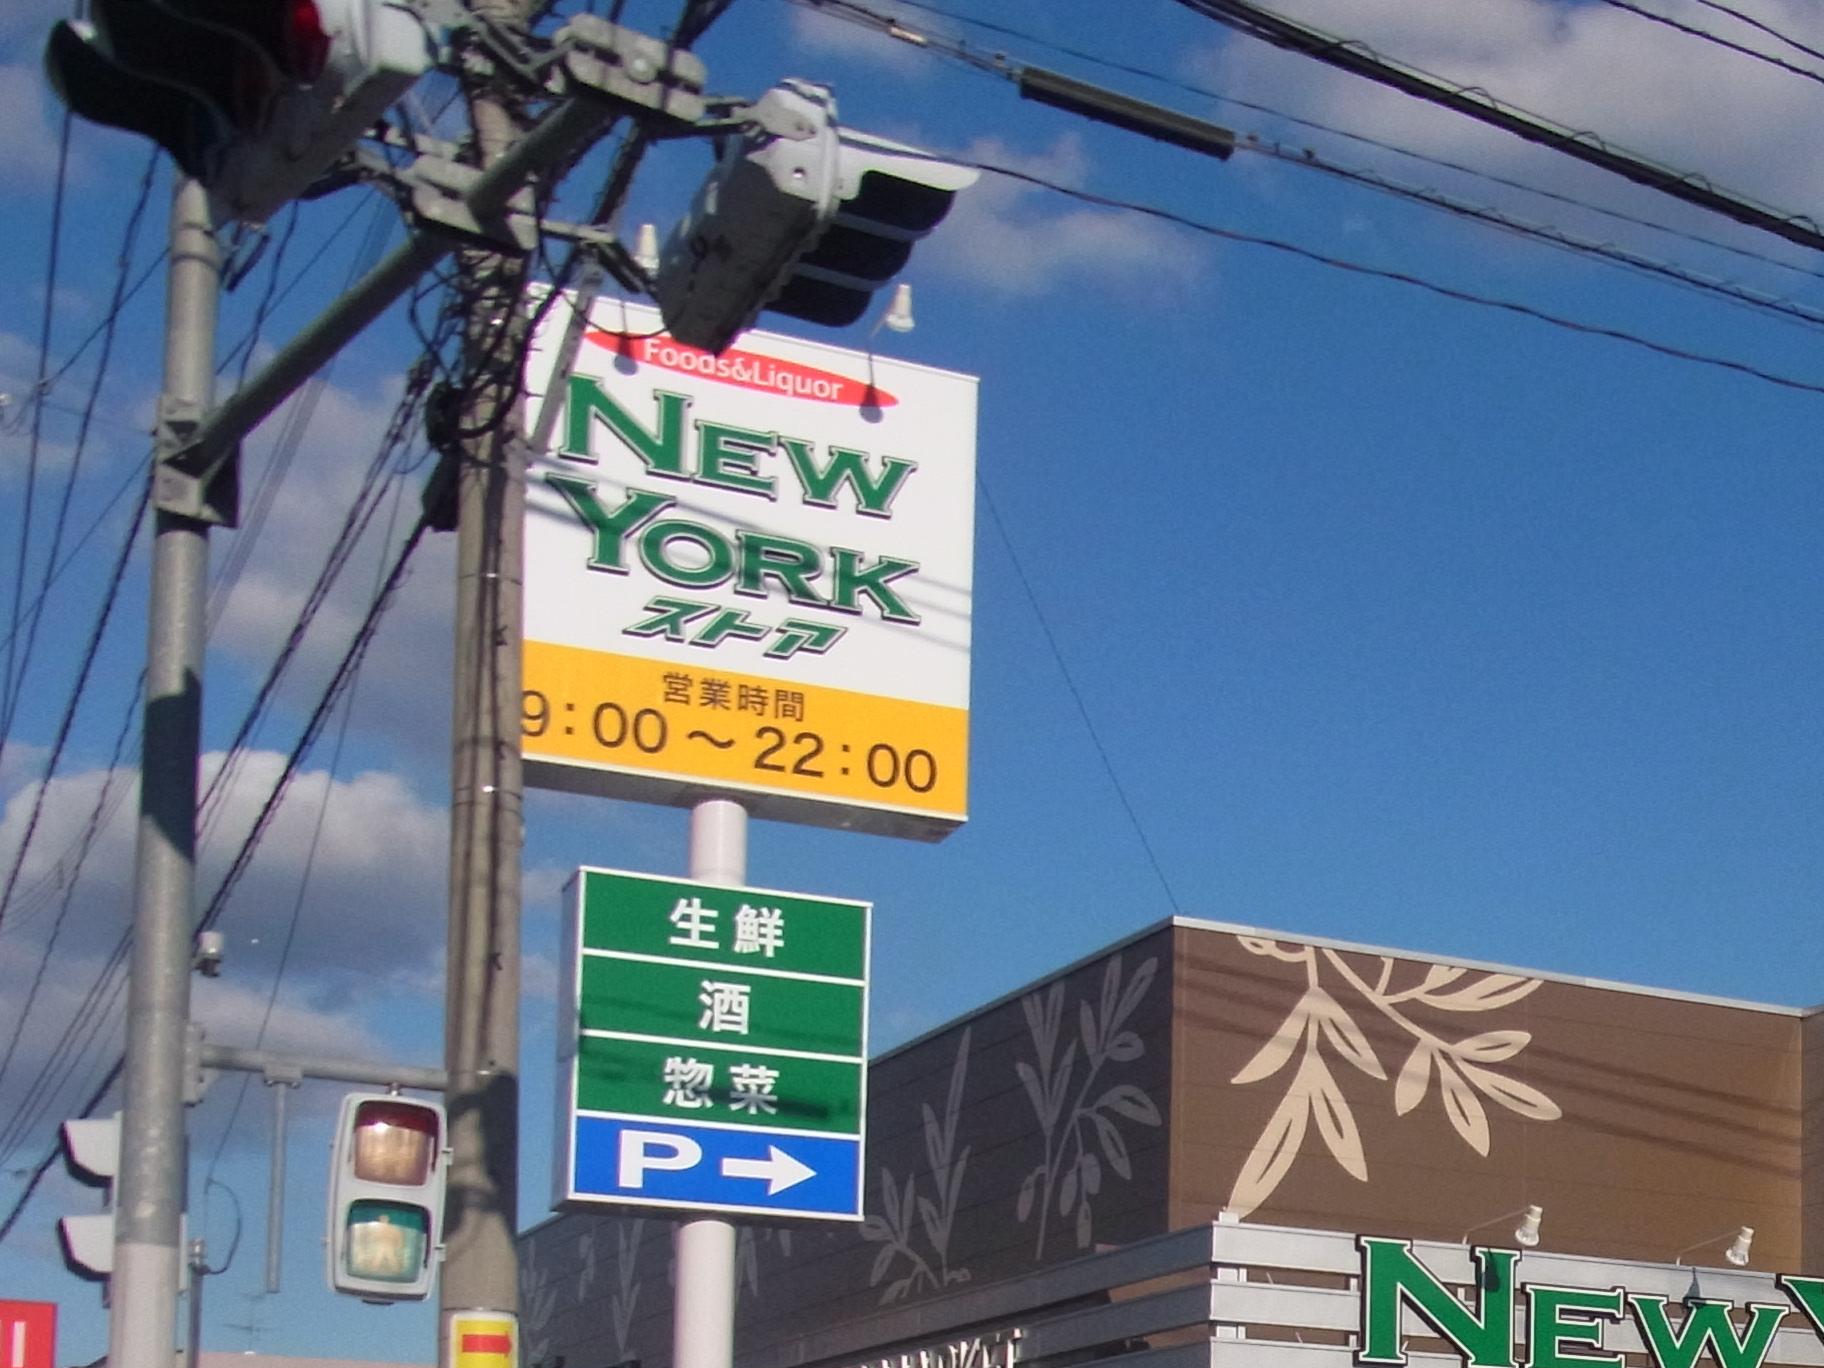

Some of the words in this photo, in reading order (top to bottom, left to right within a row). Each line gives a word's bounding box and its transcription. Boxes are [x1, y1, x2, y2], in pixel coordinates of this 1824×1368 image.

[642, 337, 844, 401] Foods&Liquor
[558, 373, 917, 519] NEW
[545, 472, 922, 625] YORK
[622, 595, 848, 660] ストア
[662, 672, 805, 722] 営業時間
[668, 898, 785, 958] 生鮮
[698, 980, 751, 1035] 酒
[662, 1056, 780, 1115] 惣菜
[618, 1130, 702, 1188] P
